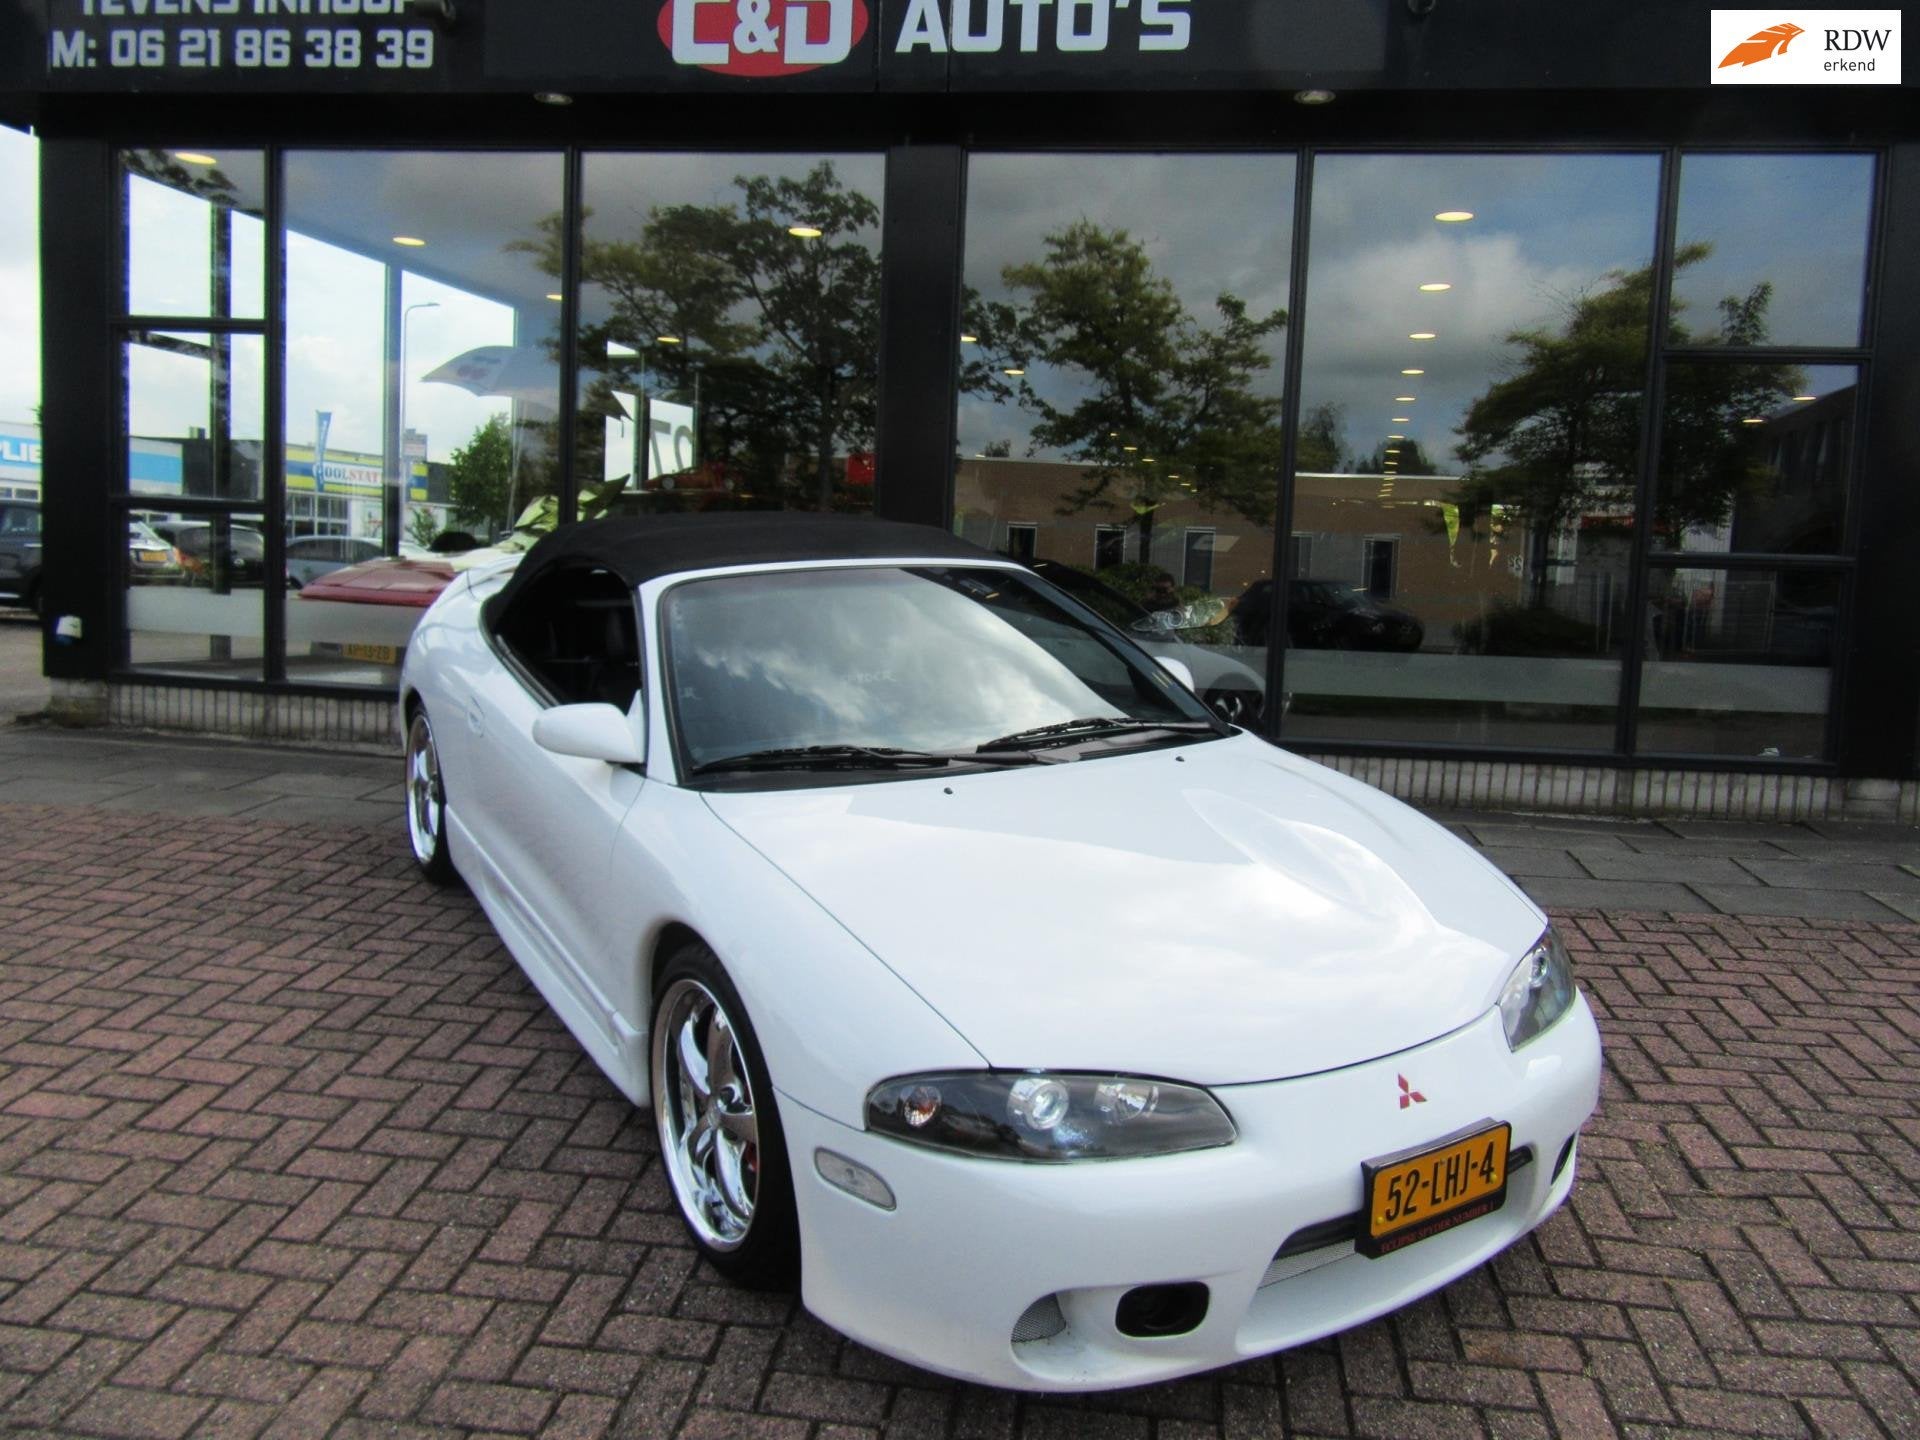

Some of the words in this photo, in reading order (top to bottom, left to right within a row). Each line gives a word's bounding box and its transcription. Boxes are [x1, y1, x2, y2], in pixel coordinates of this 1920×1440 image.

[52, 30, 96, 67] M:
[111, 30, 165, 67] 06
[179, 30, 221, 67] 21
[235, 30, 291, 67] 86
[305, 30, 362, 67] 38
[376, 30, 434, 67] 39
[672, 0, 853, 64] C&D
[1385, 1141, 1495, 1222] 52-LHJ-4
